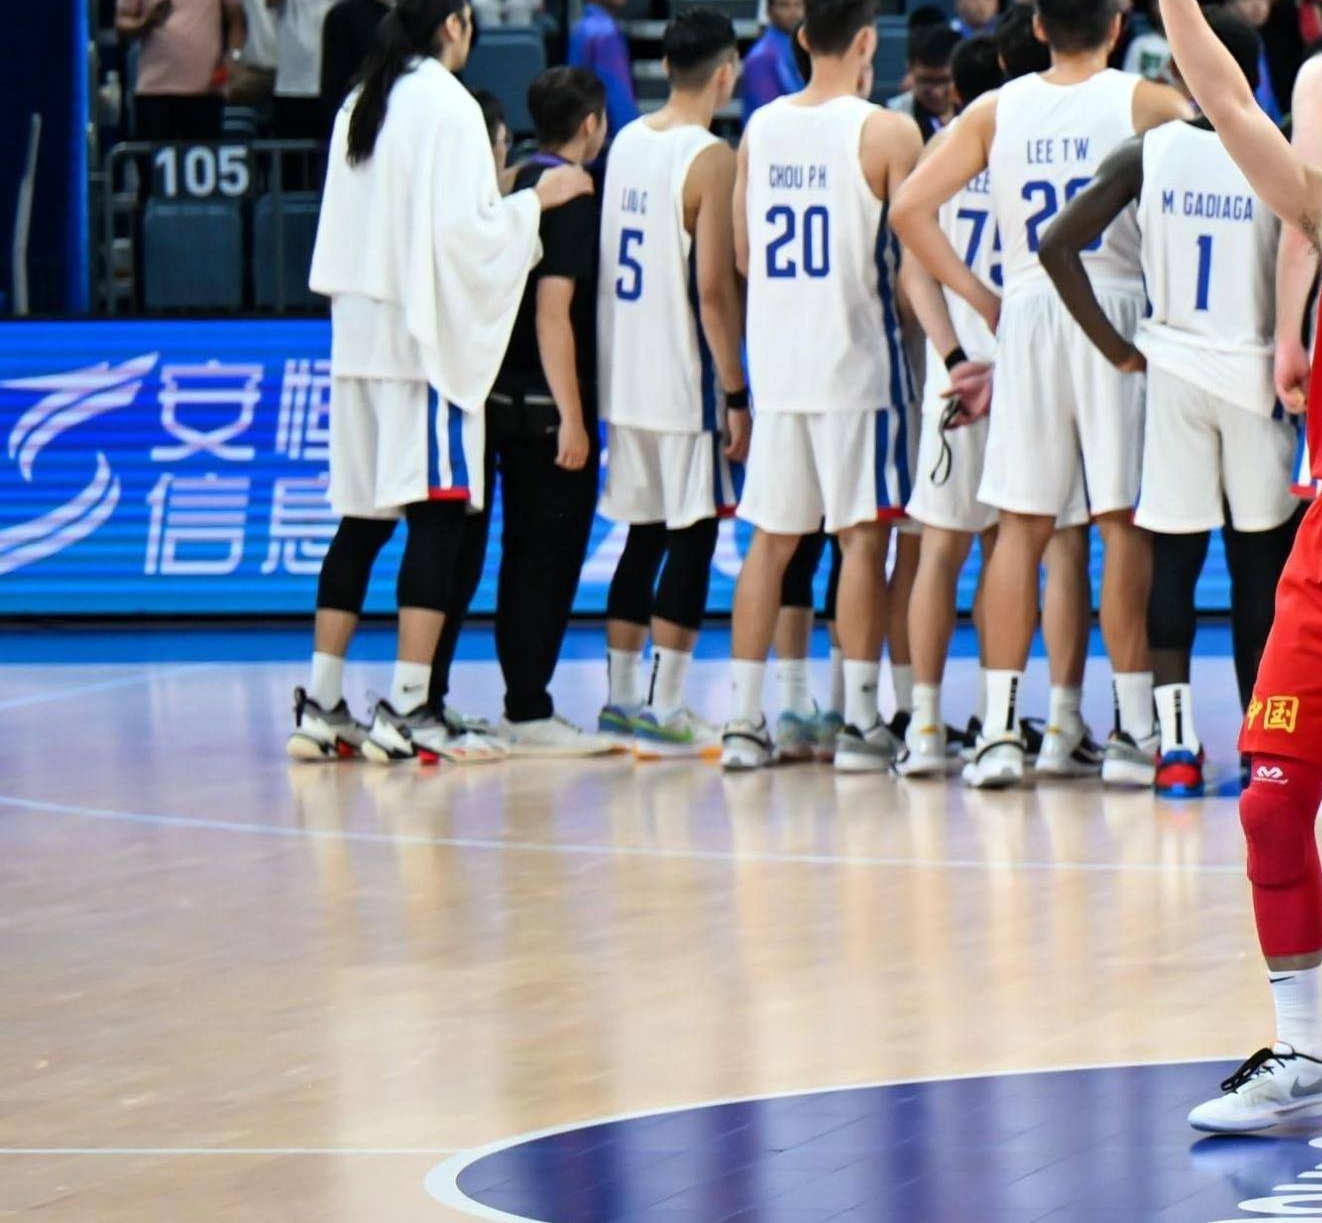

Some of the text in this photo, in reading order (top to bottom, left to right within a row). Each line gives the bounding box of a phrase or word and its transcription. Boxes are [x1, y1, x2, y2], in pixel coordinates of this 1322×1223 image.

[154, 145, 250, 198] 105
[1027, 139, 1054, 165] LEE
[1183, 191, 1254, 221] GADIAGA
[615, 227, 644, 302] 5
[765, 205, 831, 278] 20
[1195, 235, 1213, 311] 1
